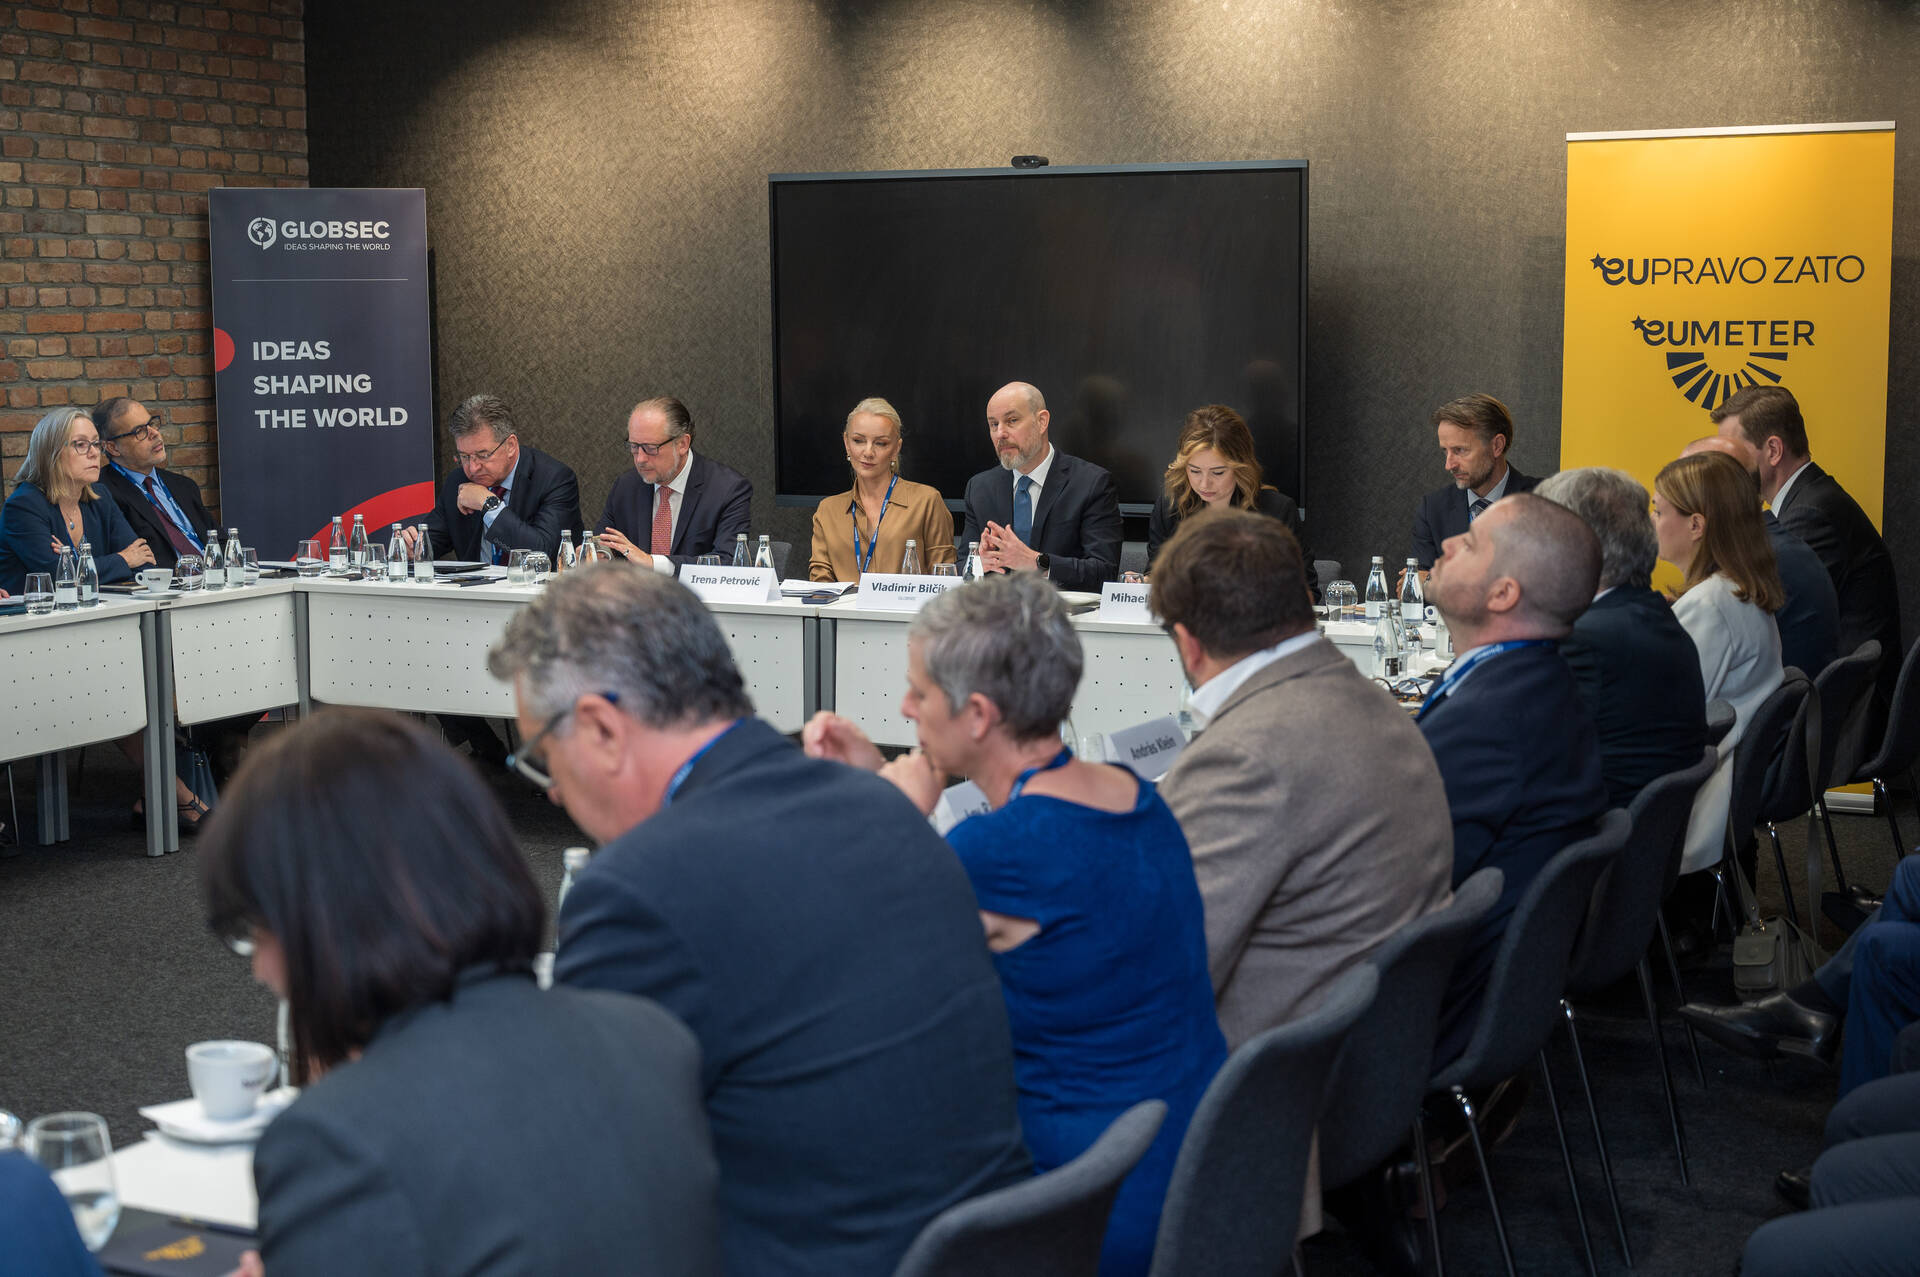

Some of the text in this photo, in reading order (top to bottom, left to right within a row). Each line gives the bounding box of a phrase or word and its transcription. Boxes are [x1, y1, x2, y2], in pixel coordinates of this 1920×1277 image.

[281, 221, 390, 239] GLOBSEC
[284, 243, 391, 251] IDEAS SHAPING THE WORLD
[1773, 255, 1865, 283] ZATO
[252, 340, 331, 361] IDEAS
[253, 374, 372, 395] SHAPING
[255, 407, 409, 429] THE WORLD
[690, 574, 761, 586] Irena Petrović
[871, 582, 916, 593] Vladimír
[1155, 735, 1177, 752] Klein
